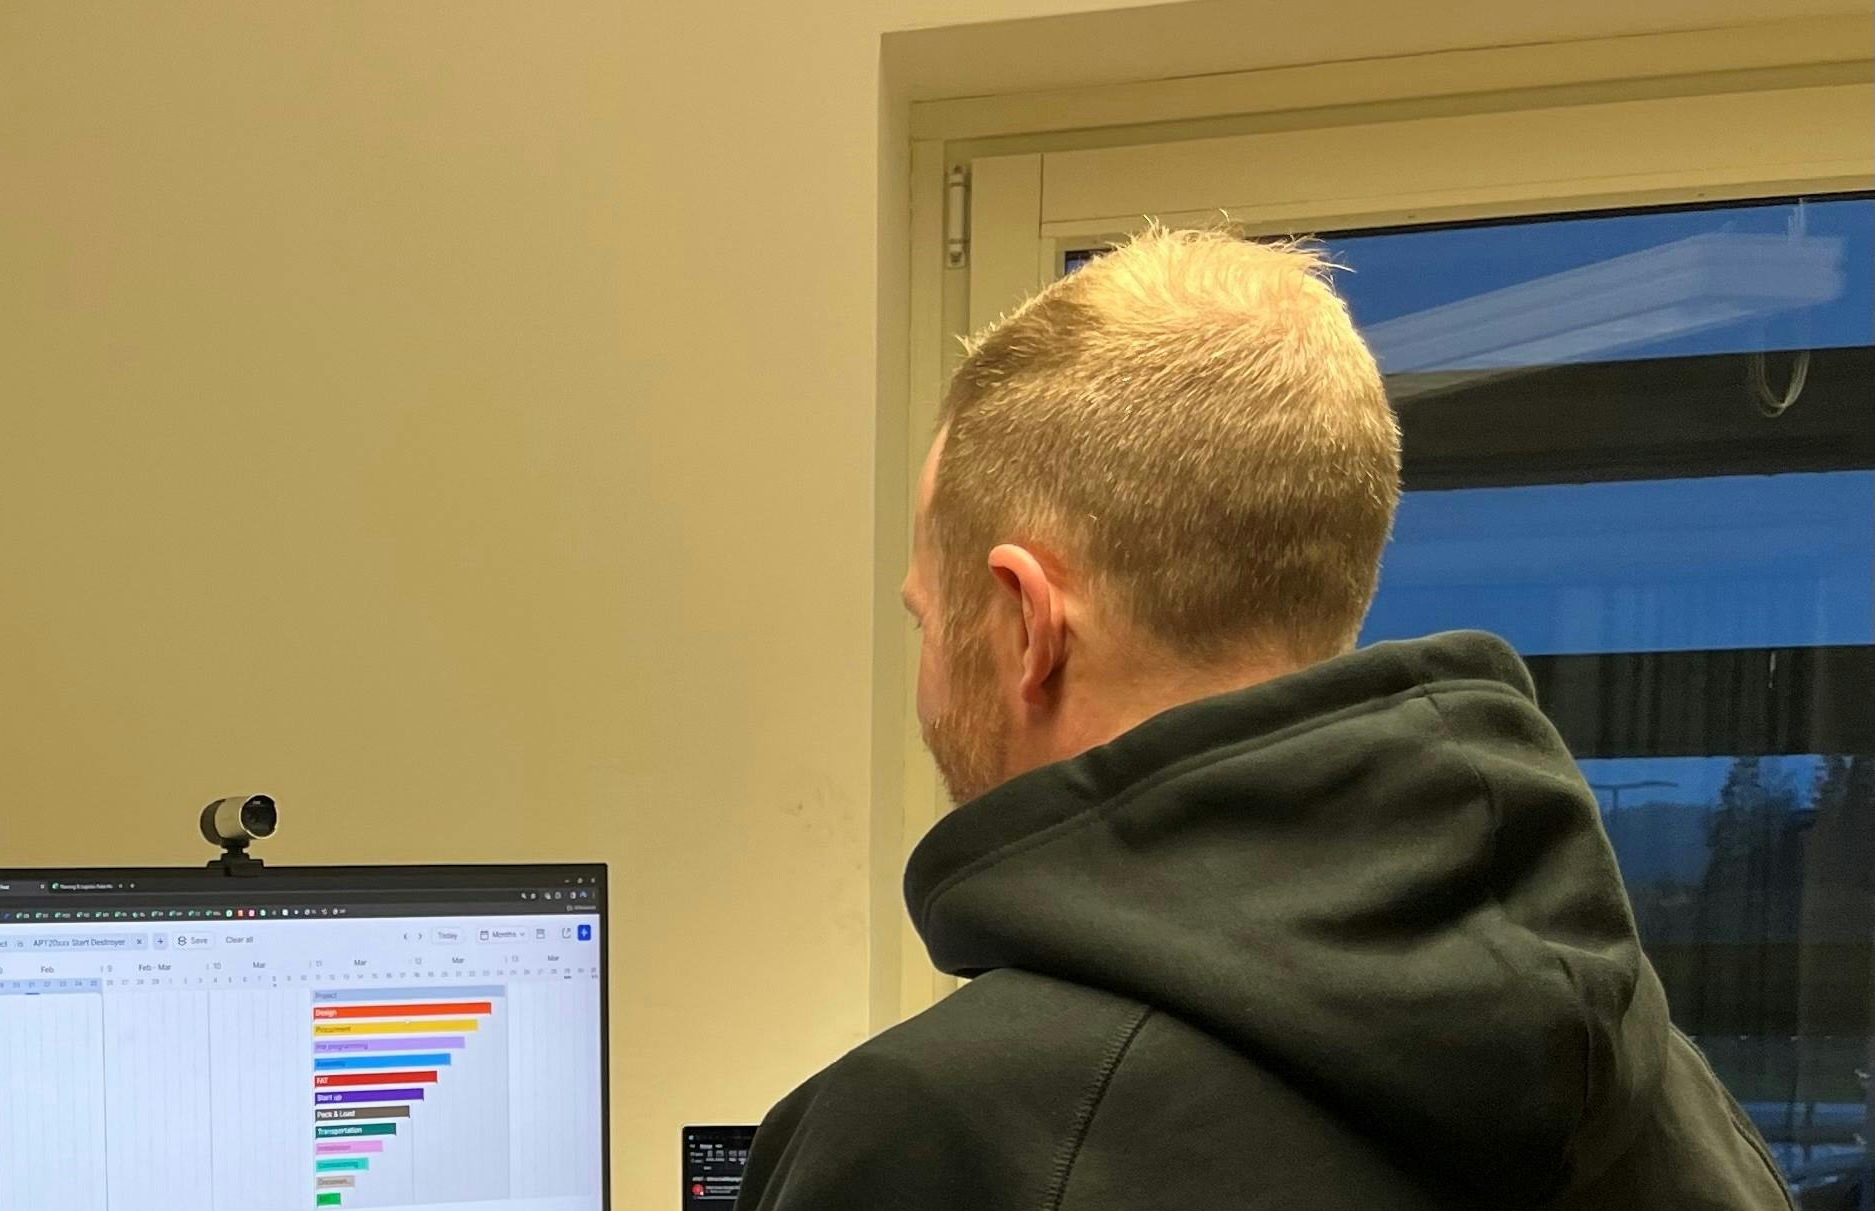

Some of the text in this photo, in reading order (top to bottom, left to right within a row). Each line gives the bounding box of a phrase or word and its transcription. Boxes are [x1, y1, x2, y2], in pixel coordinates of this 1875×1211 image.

[437, 931, 458, 941] Today
[492, 930, 517, 938] Months
[72, 938, 90, 947] Start
[190, 936, 208, 945] Save
[225, 936, 245, 944] Clear
[39, 965, 55, 974] Feb
[315, 1009, 338, 1018] Design
